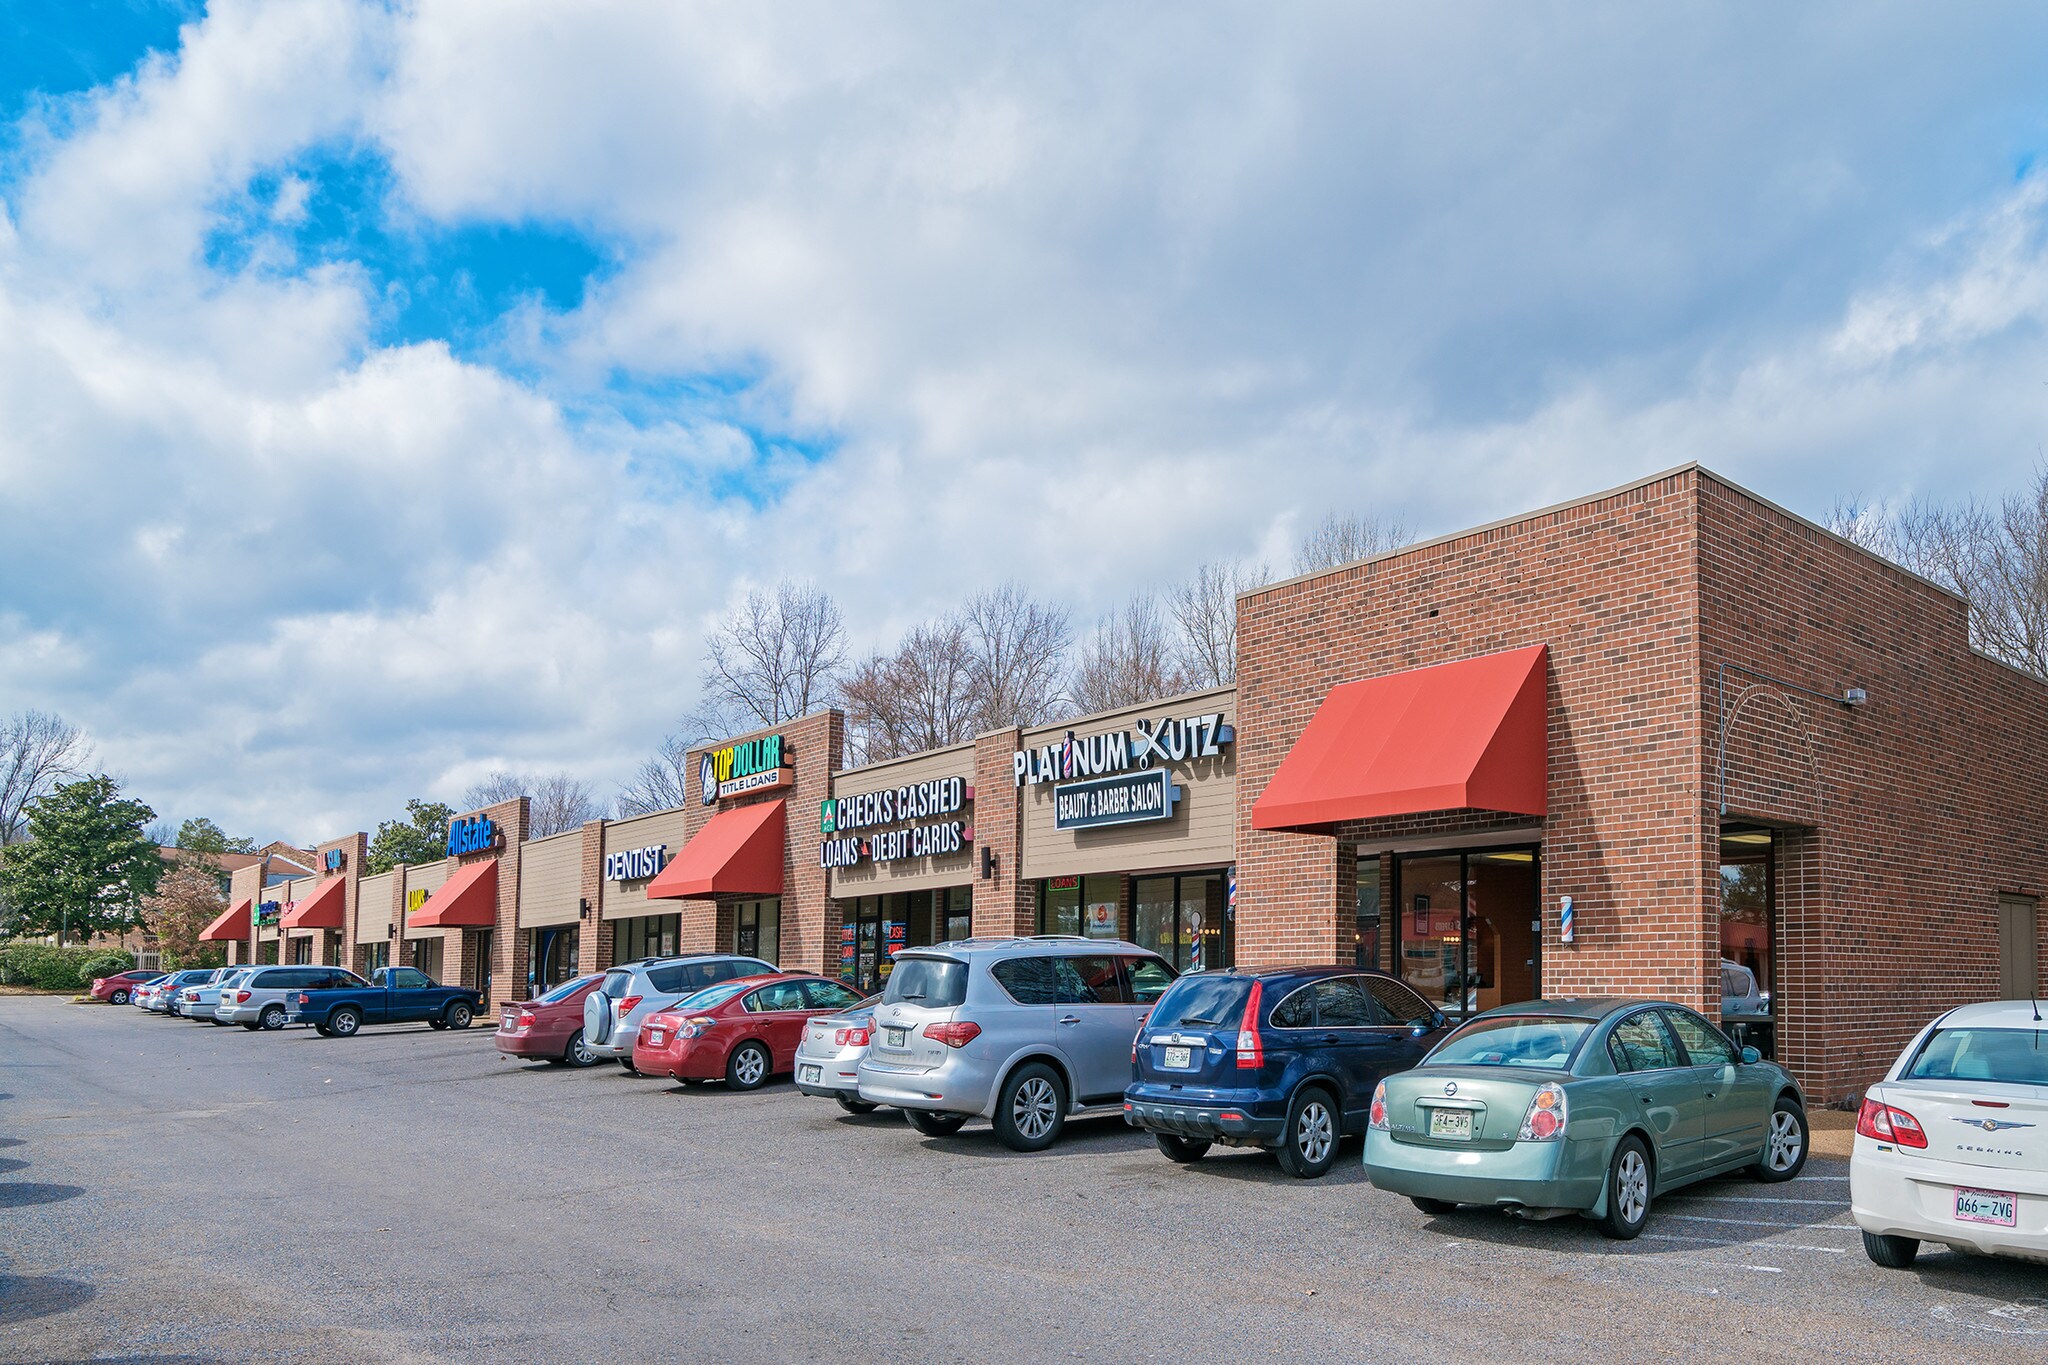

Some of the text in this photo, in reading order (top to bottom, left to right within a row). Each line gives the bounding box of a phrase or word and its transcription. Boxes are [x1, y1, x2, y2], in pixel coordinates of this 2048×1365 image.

[721, 772, 777, 794] TITLE LOANS
[1058, 782, 1161, 821] BEAUTY & BARBER SALON
[837, 776, 961, 830] CHECKS CASHED
[447, 817, 492, 857] Allstate
[820, 821, 960, 868] LOANS DEBIT CARDS
[606, 845, 662, 881] DENTIST
[1050, 876, 1078, 889] LOANS
